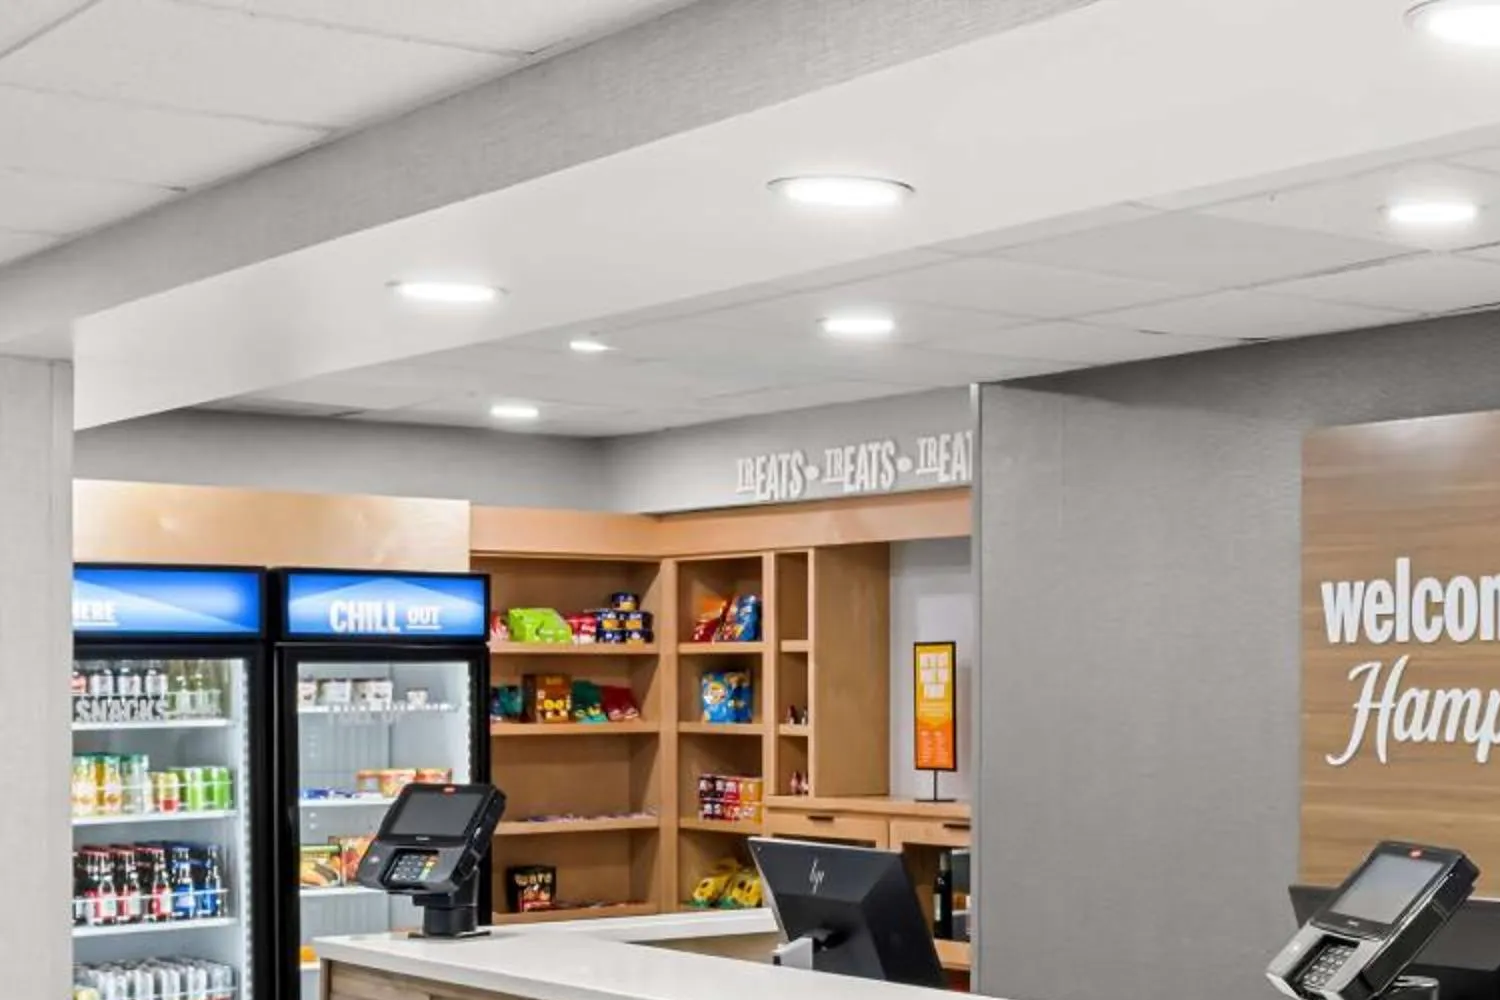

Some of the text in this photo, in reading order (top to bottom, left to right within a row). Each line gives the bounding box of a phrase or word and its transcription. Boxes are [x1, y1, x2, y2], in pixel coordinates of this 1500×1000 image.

[736, 449, 804, 500] TREATS
[822, 440, 896, 492] TREATS
[329, 600, 441, 633] CHILL OUT
